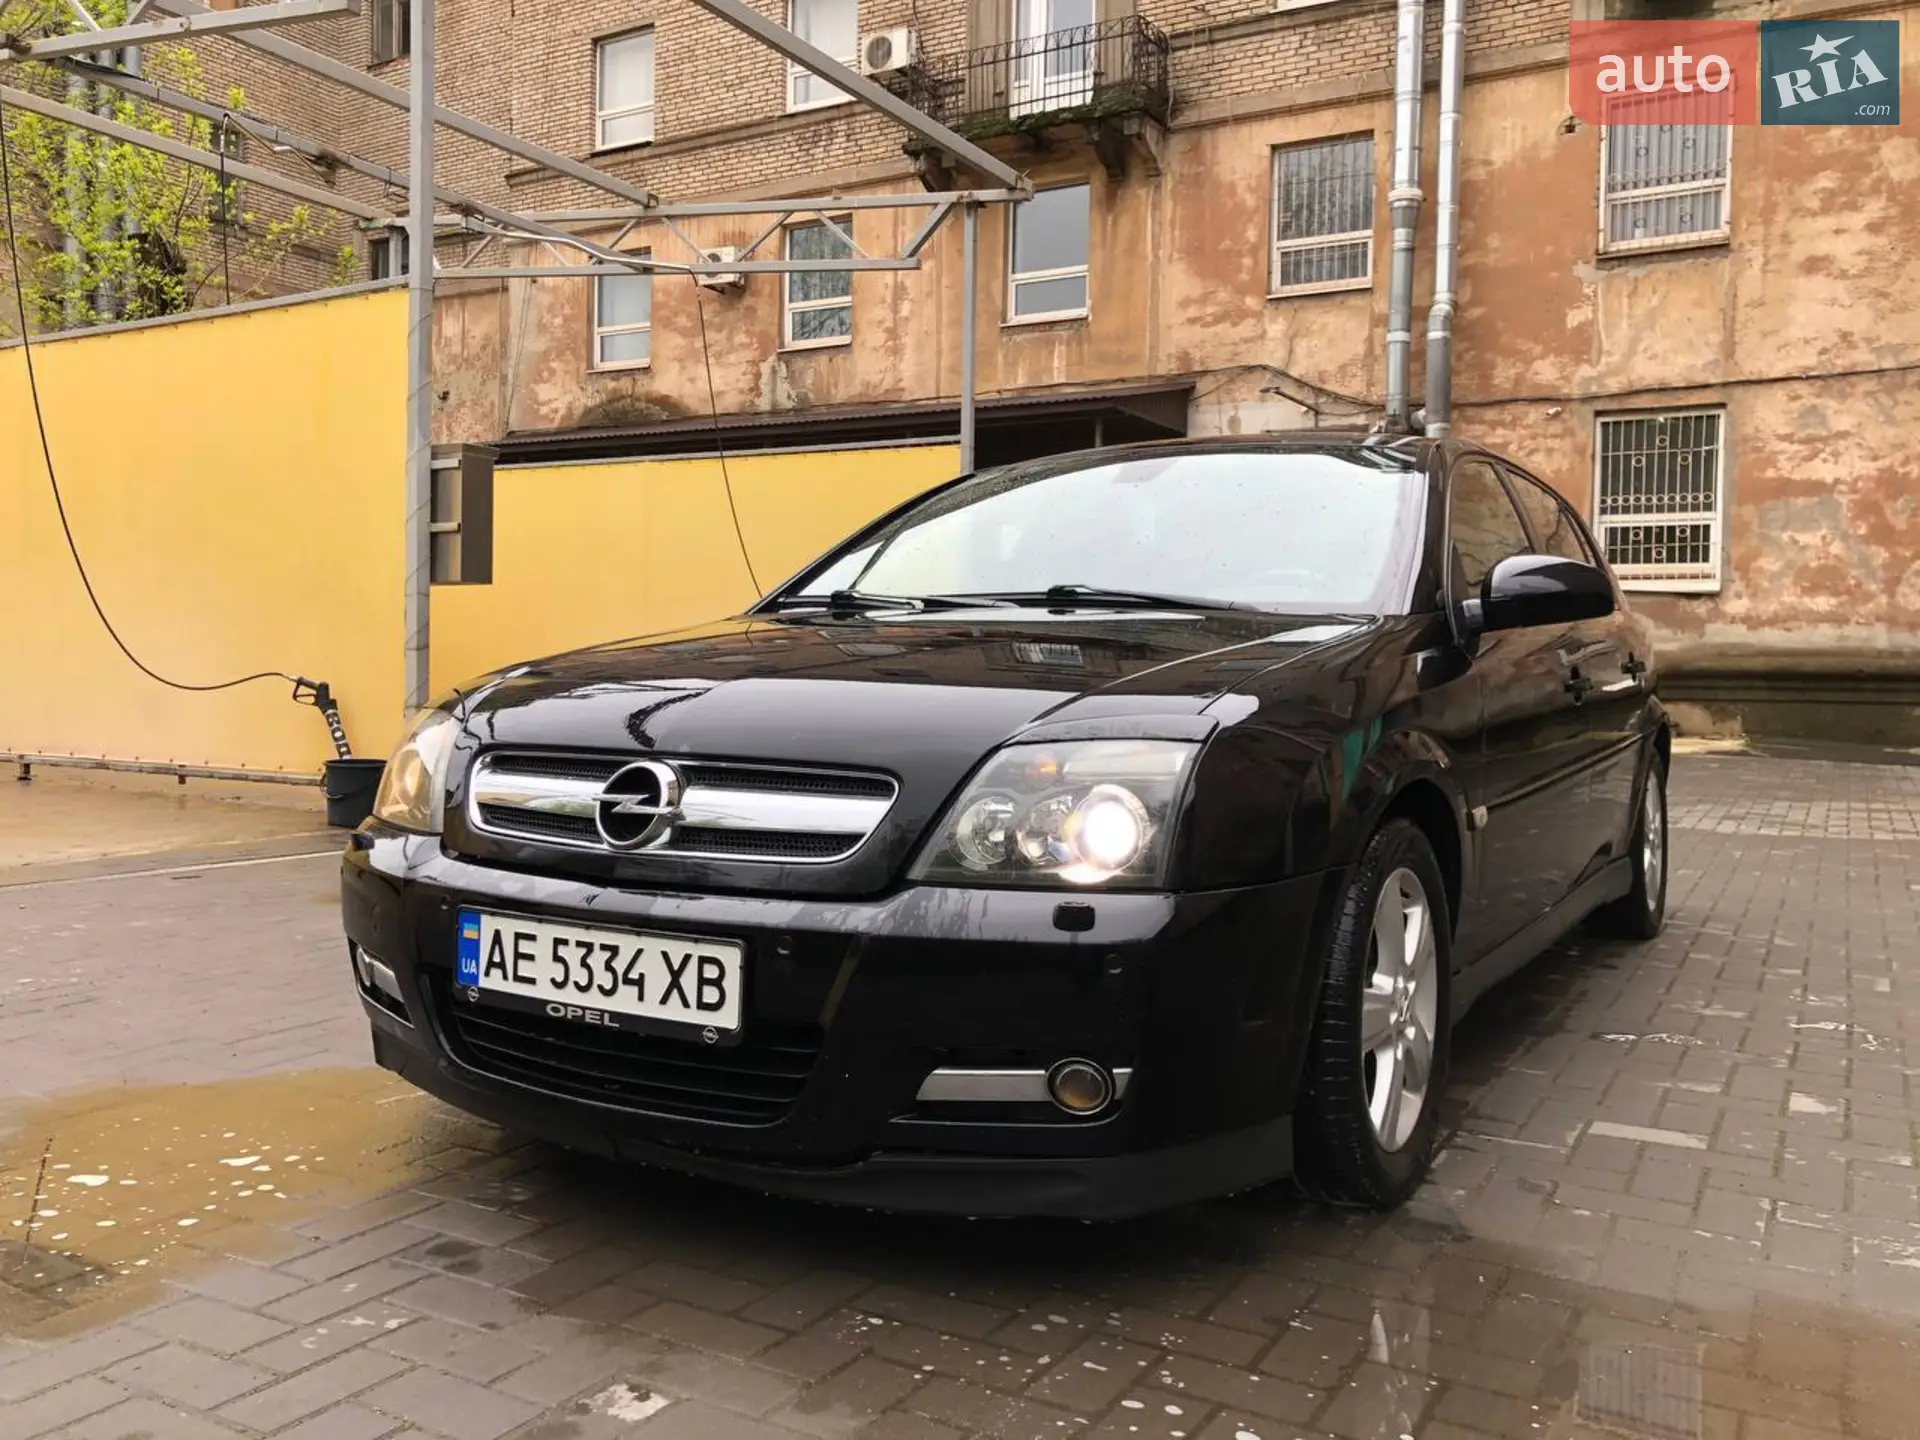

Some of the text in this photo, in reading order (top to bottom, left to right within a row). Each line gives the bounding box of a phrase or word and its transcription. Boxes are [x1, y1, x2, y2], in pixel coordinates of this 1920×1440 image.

[461, 957, 478, 976] UA
[484, 928, 727, 1013] AE 5334 XB
[545, 1003, 620, 1028] OPEL
